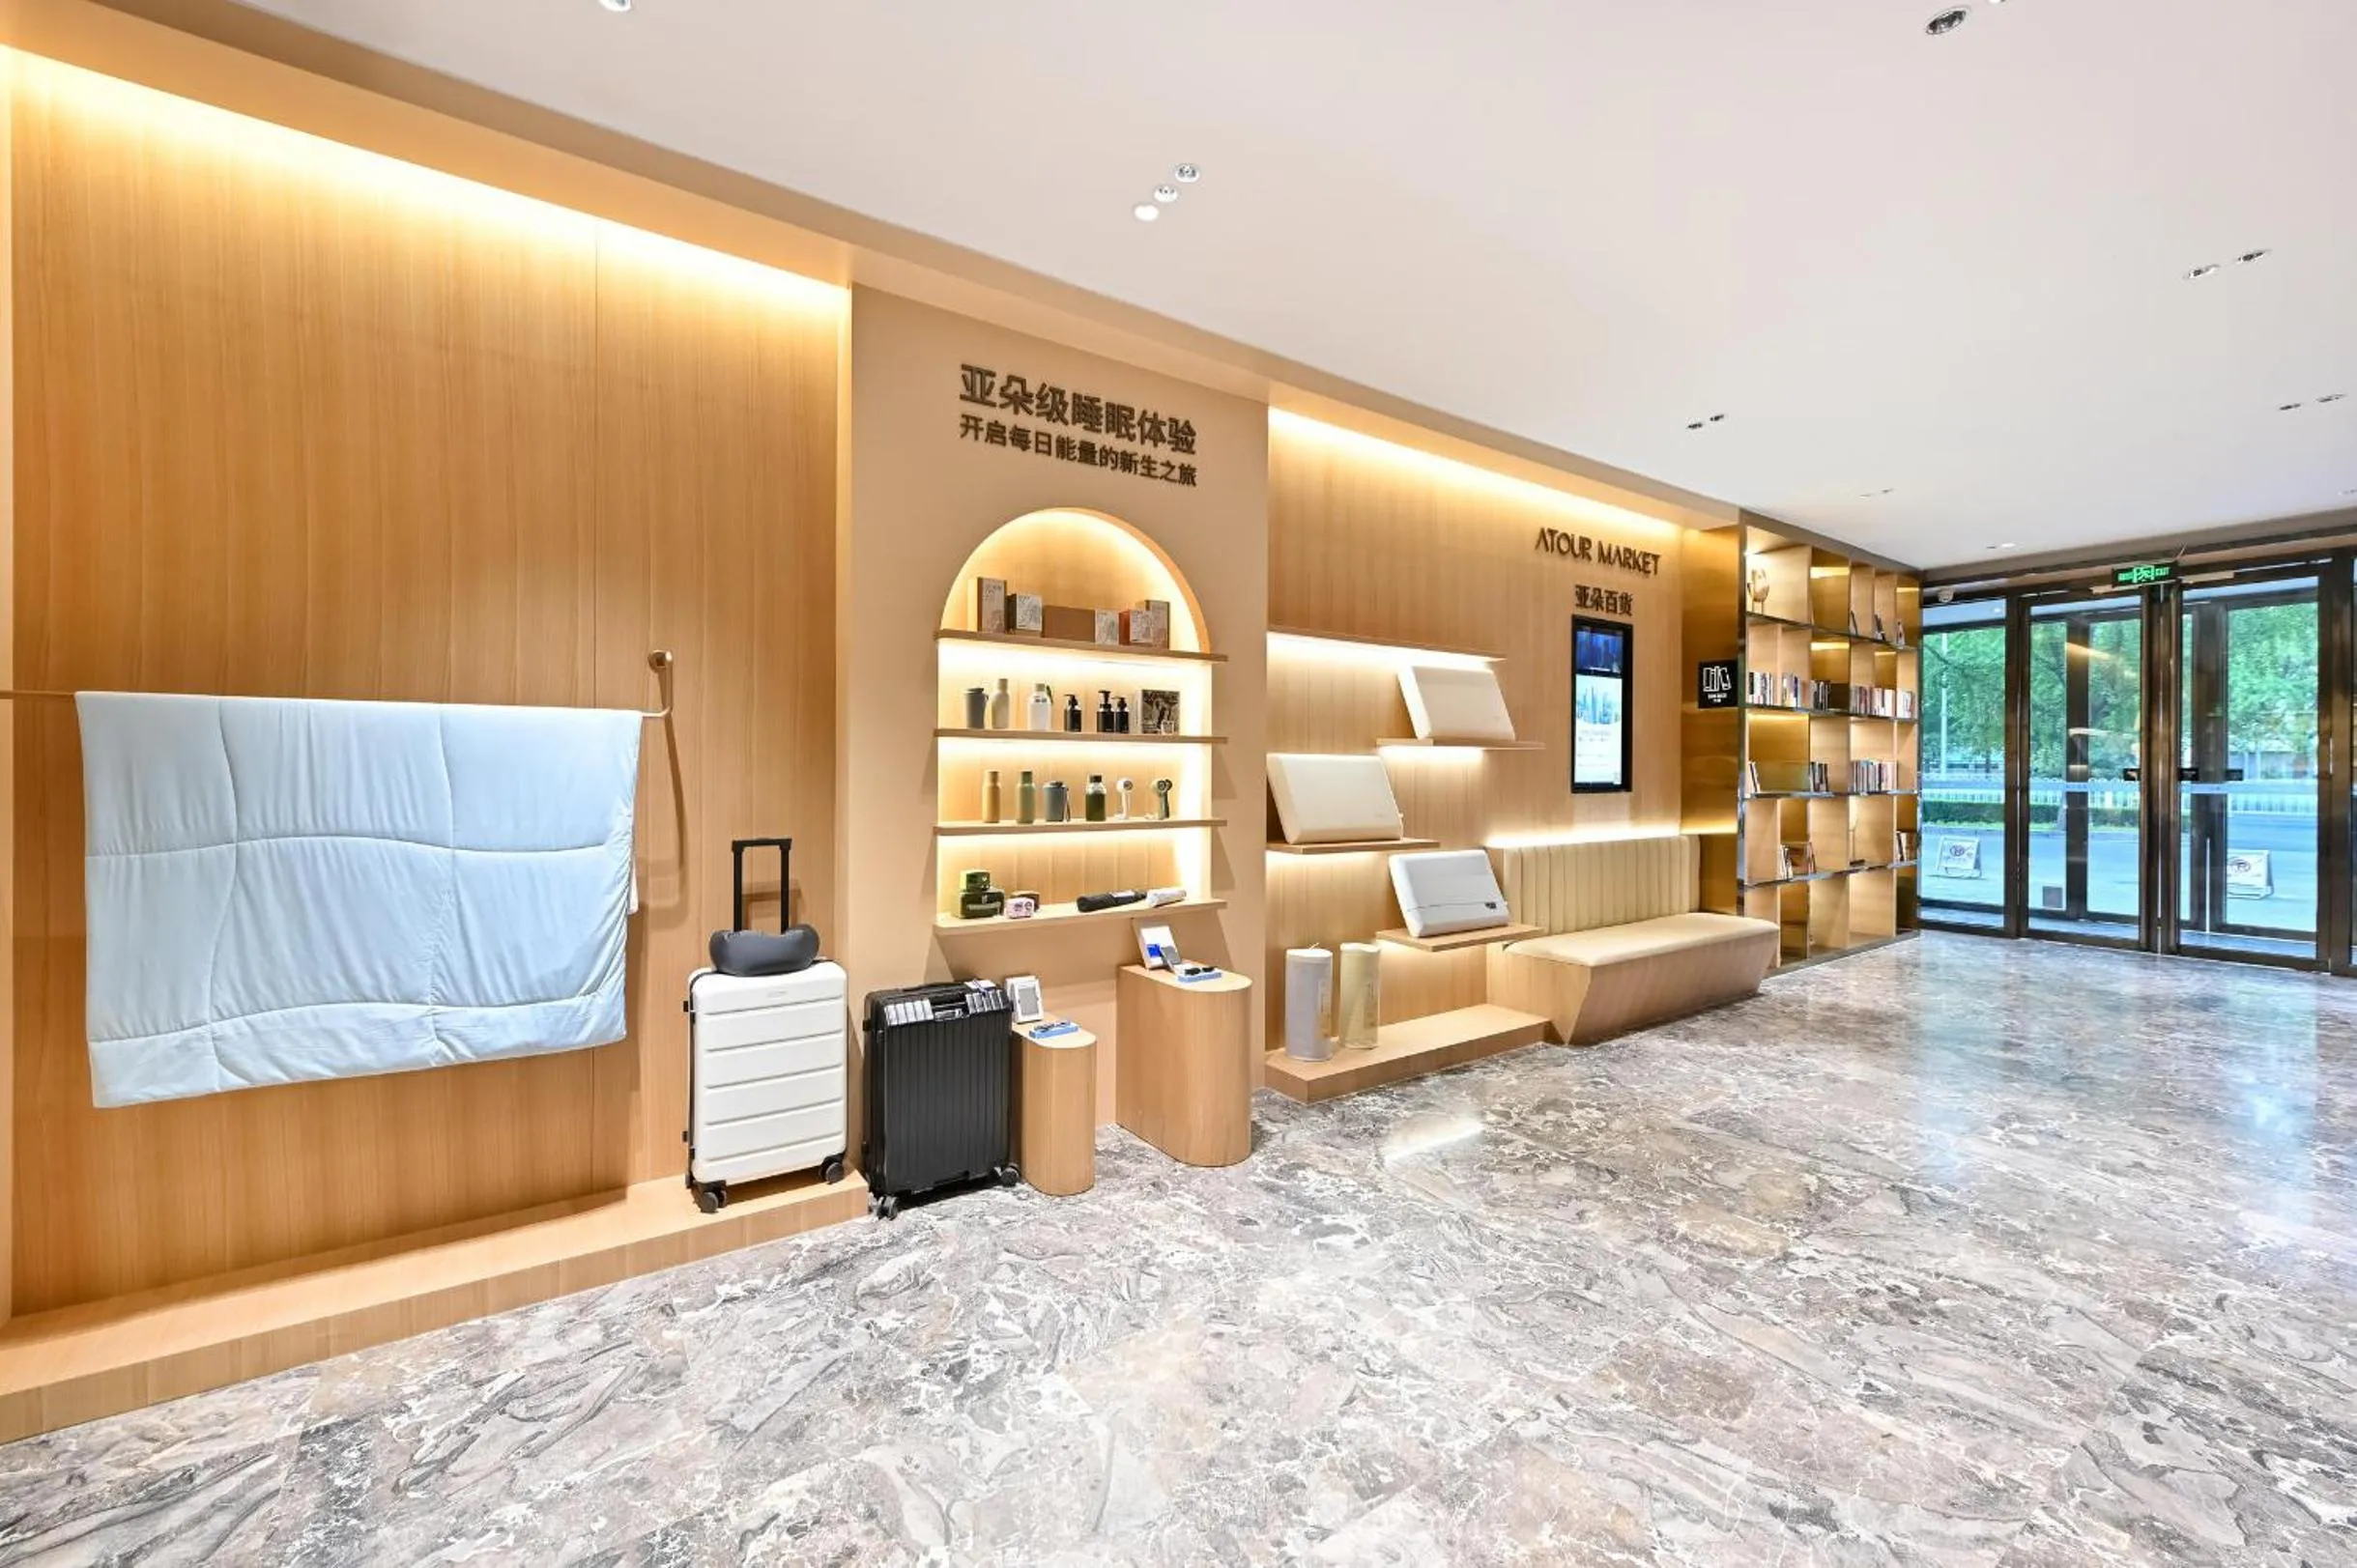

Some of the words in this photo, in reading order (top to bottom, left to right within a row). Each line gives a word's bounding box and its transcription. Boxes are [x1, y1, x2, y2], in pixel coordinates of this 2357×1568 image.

[959, 363, 1197, 455] 亚朵级睡眠体验
[959, 413, 1197, 487] 开启每日能量的新生之旅
[1535, 527, 1593, 561] ATOUR
[1597, 541, 1660, 576] MARKET
[1574, 584, 1633, 615] 亚朵百货
